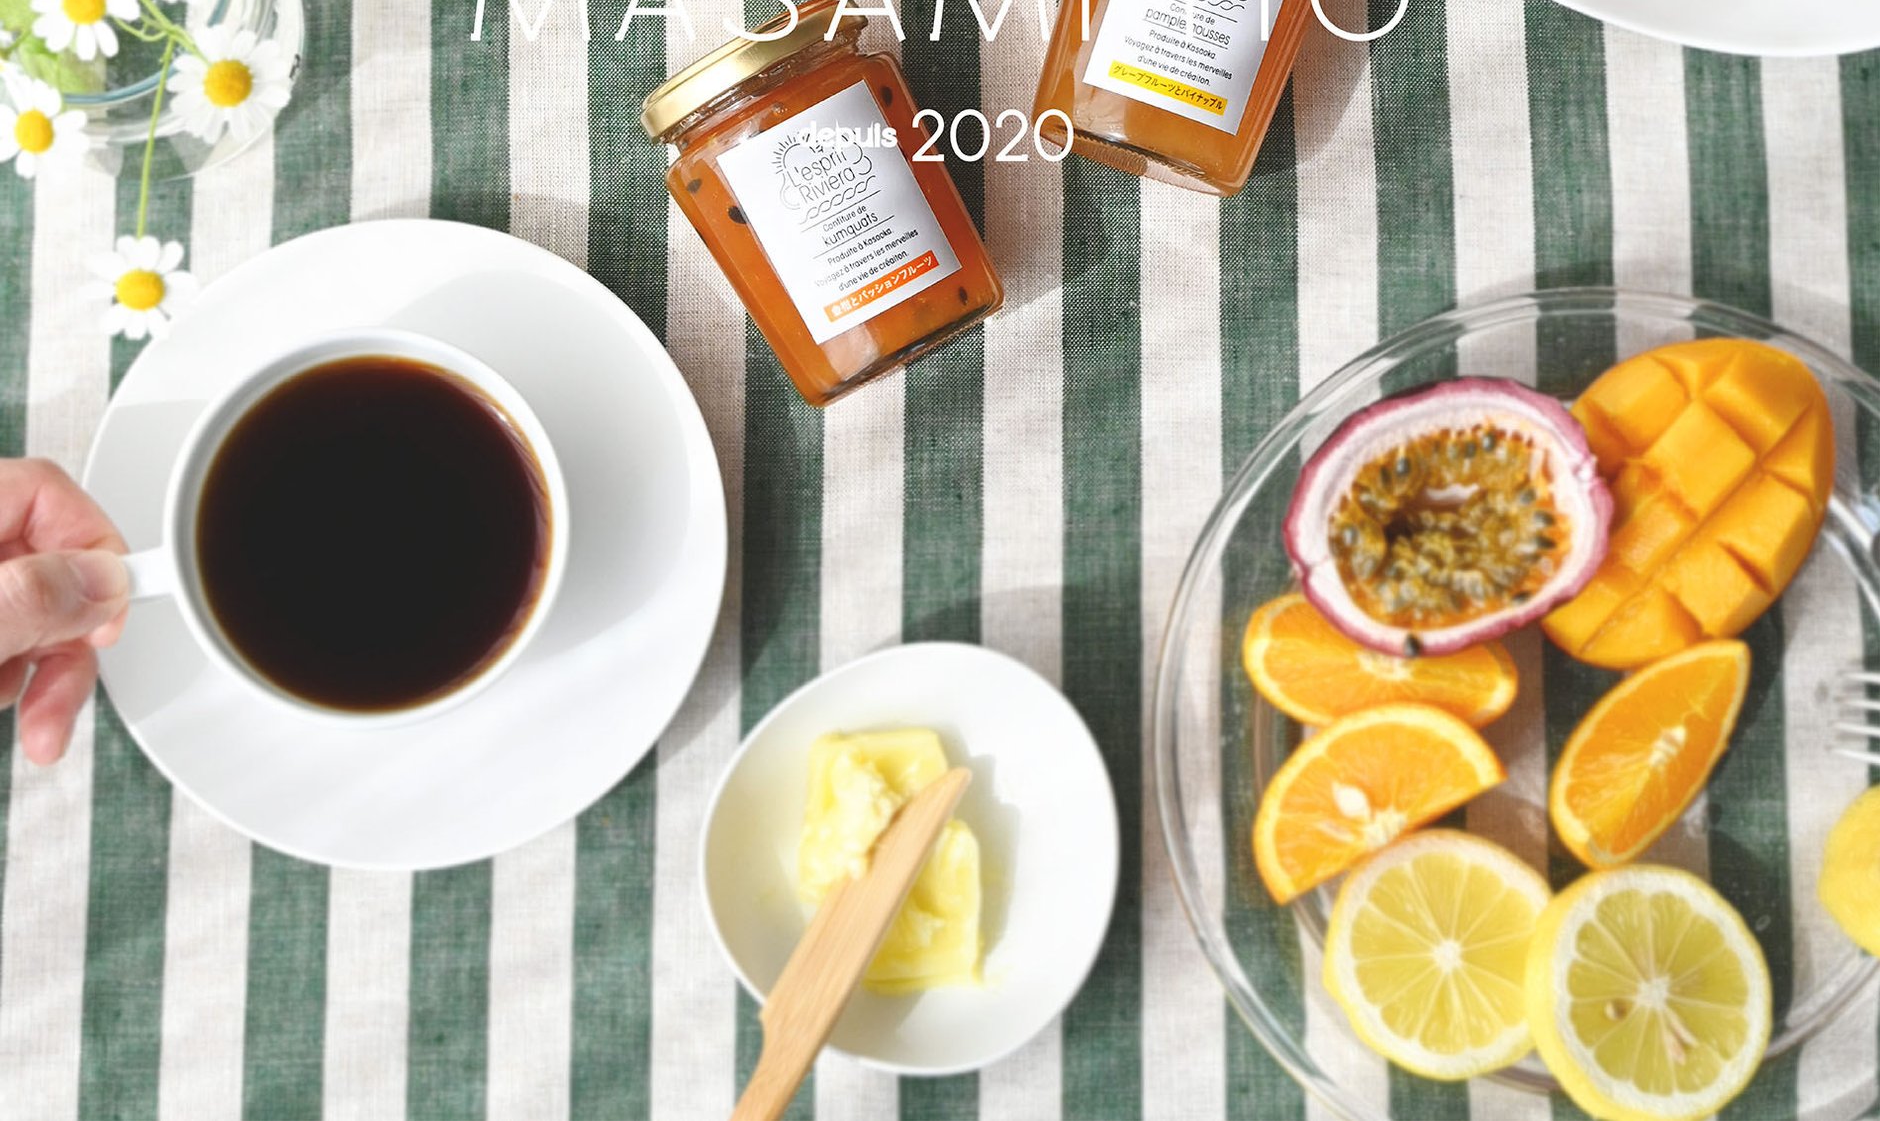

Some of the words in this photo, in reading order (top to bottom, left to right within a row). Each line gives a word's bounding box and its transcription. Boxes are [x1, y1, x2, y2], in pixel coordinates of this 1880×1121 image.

[1205, 14, 1216, 25] de
[1149, 29, 1180, 46] Produite
[1124, 35, 1154, 52] Voyagez
[1160, 48, 1186, 63] travers
[1197, 61, 1233, 80] merveilles
[1158, 62, 1169, 71] vie
[1169, 65, 1180, 75] de
[1113, 64, 1224, 110] グレープフルーツとパイナップル
[798, 166, 856, 203] Riviera
[822, 211, 856, 232] Confiture
[856, 204, 867, 216] de
[822, 212, 878, 247] kumquats
[827, 246, 858, 265] Produite
[849, 253, 874, 270] travers
[885, 229, 919, 251] merveilles
[858, 271, 869, 281] vie
[869, 265, 879, 275] de
